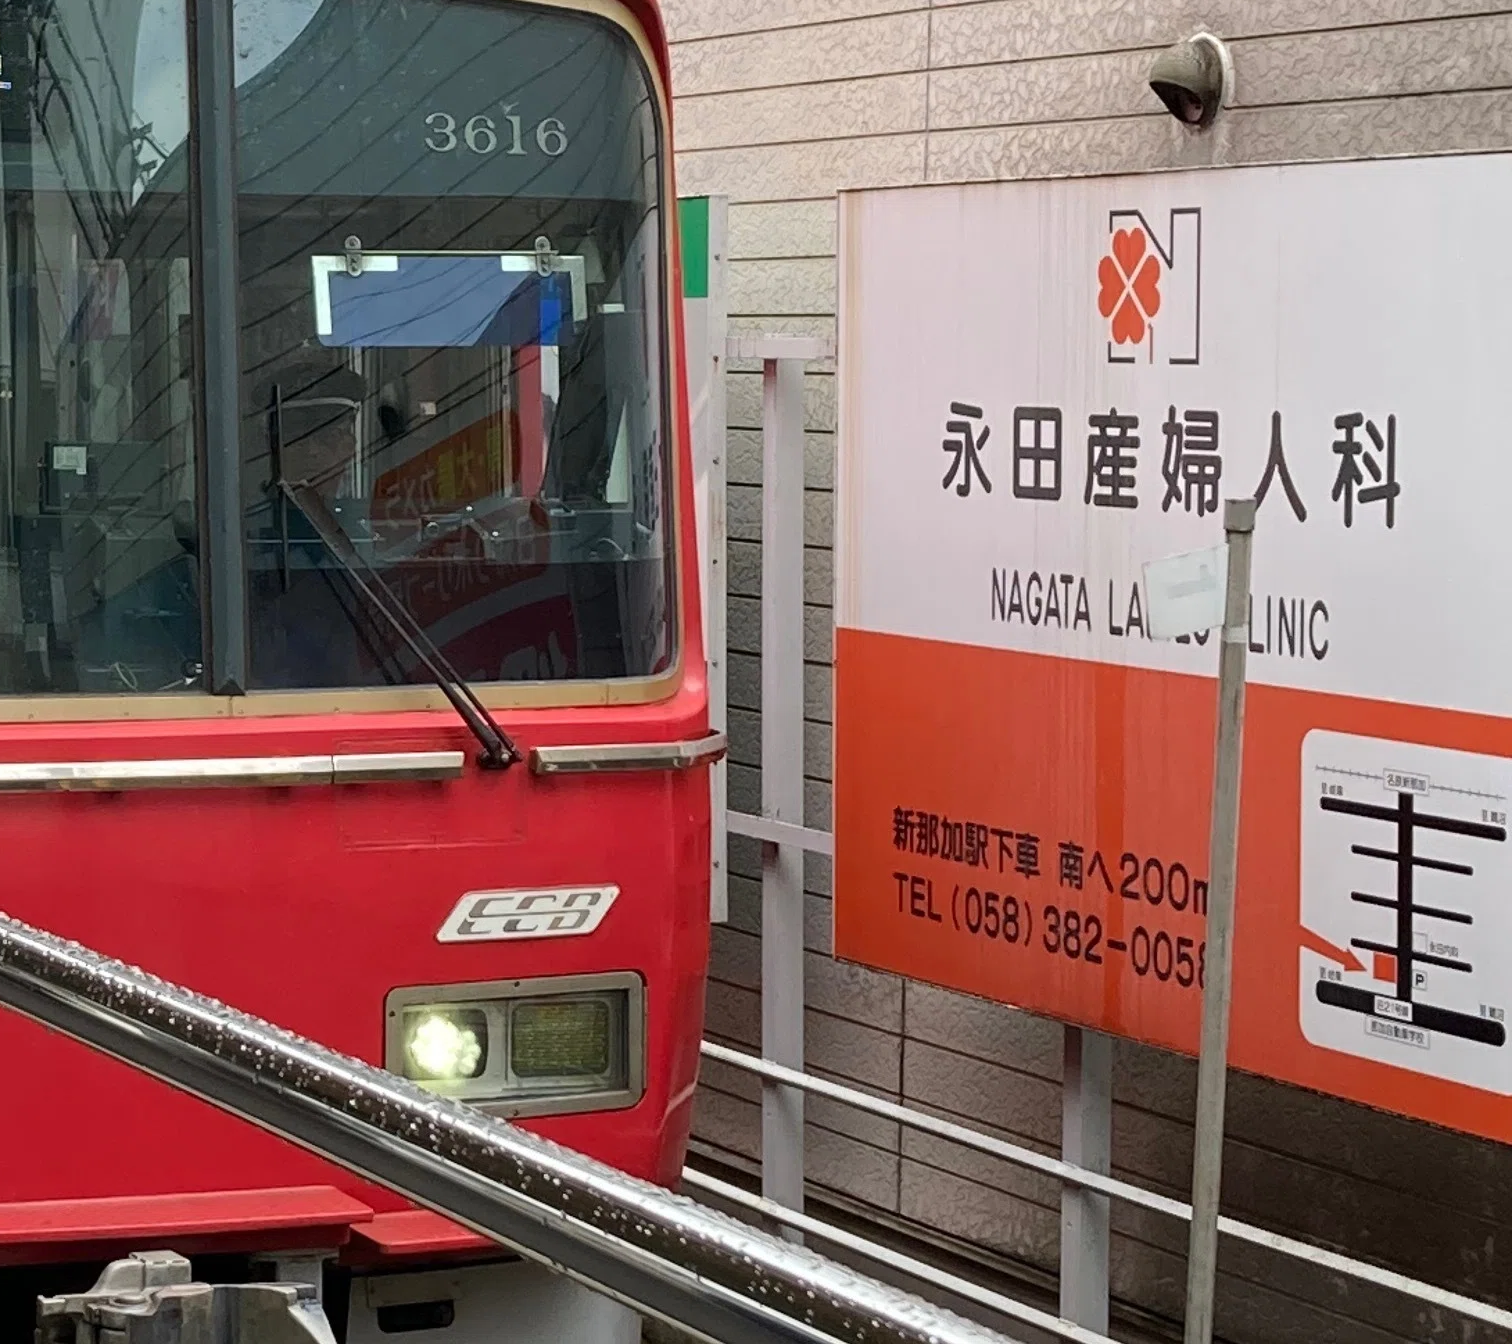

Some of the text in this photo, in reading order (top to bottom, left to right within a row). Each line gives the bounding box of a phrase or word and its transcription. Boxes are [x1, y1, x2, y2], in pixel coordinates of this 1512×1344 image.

[424, 111, 569, 157] 3616
[941, 401, 1402, 530] 永田産婦人科
[991, 567, 1092, 633] NAGATA
[1246, 592, 1330, 661] LINIC
[891, 805, 1041, 880] 新那加駅下車
[891, 872, 943, 924] TEL
